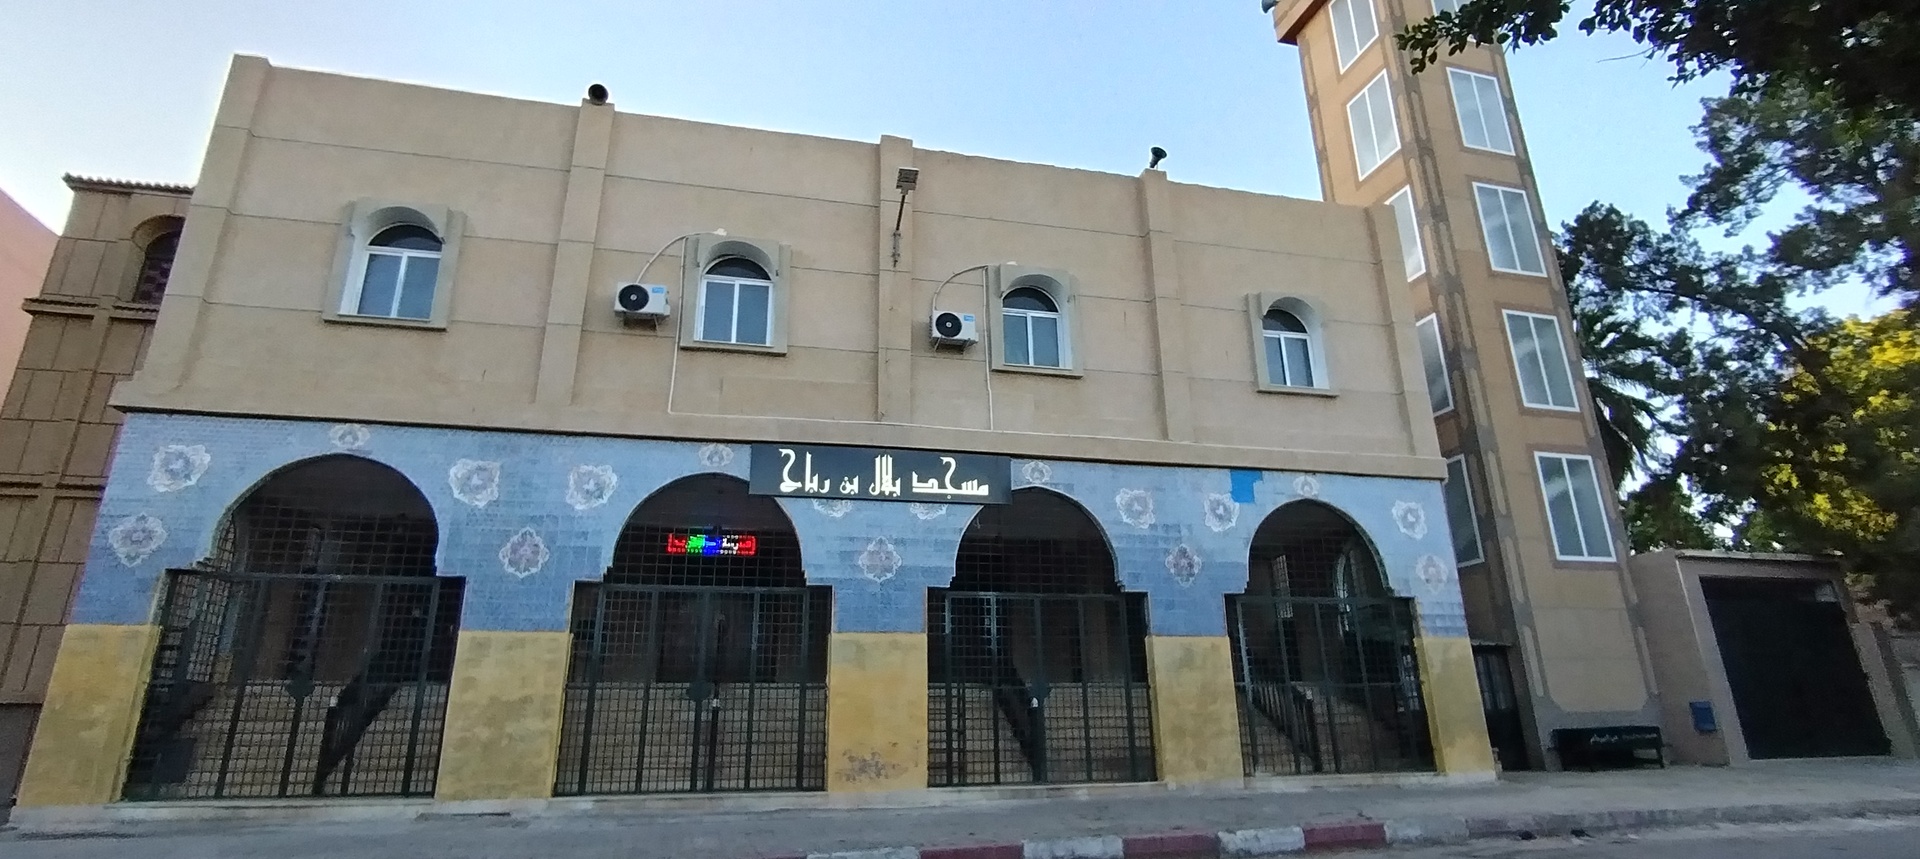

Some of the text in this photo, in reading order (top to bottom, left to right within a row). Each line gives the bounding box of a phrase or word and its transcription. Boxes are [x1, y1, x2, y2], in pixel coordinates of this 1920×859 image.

[778, 448, 989, 500] مسجد بلال بن رباح
